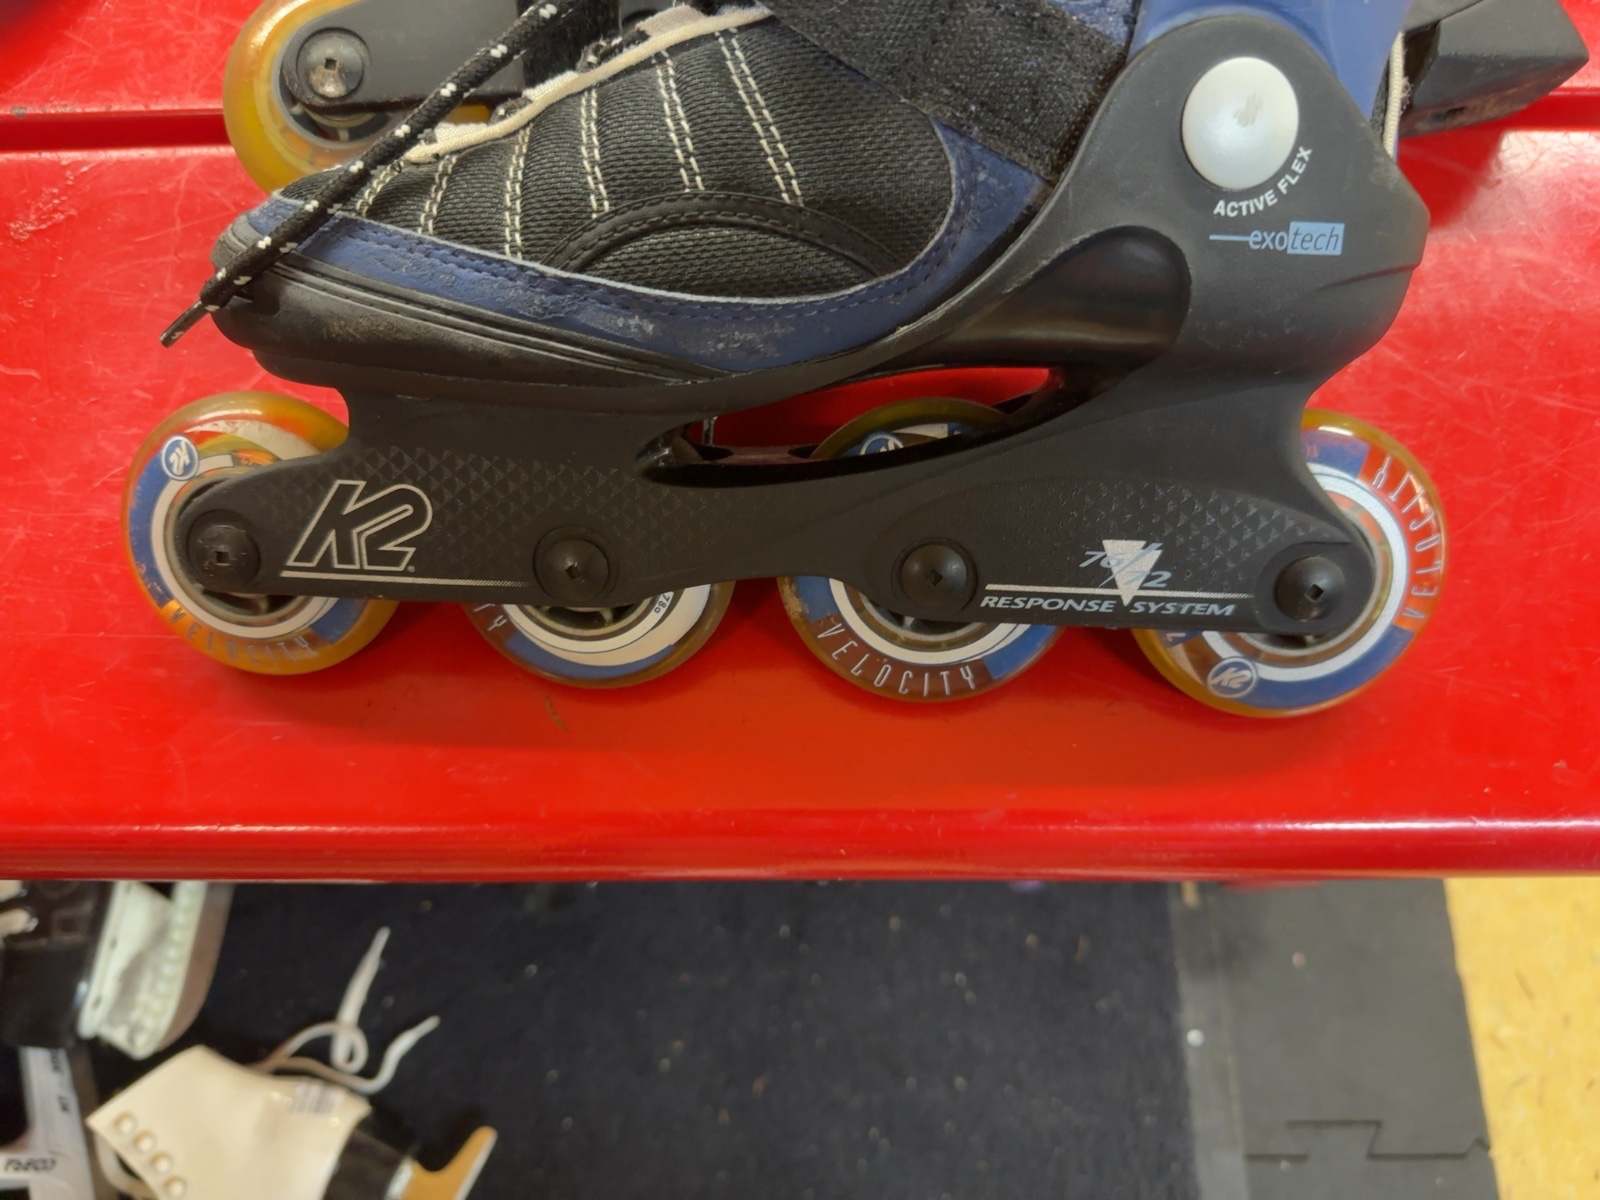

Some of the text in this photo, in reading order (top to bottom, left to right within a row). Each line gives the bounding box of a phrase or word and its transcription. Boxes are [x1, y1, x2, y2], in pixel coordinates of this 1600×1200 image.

[1213, 146, 1312, 218] ACTIVE FLEX
[1248, 225, 1341, 251] exotech
[286, 479, 433, 572] K2
[1371, 455, 1441, 620] VELOCITY
[169, 607, 320, 667] VELOCITY
[979, 596, 1237, 616] RESPONSE SYSTEM
[817, 623, 976, 697] VELOCITY
[1209, 666, 1251, 689] K2
